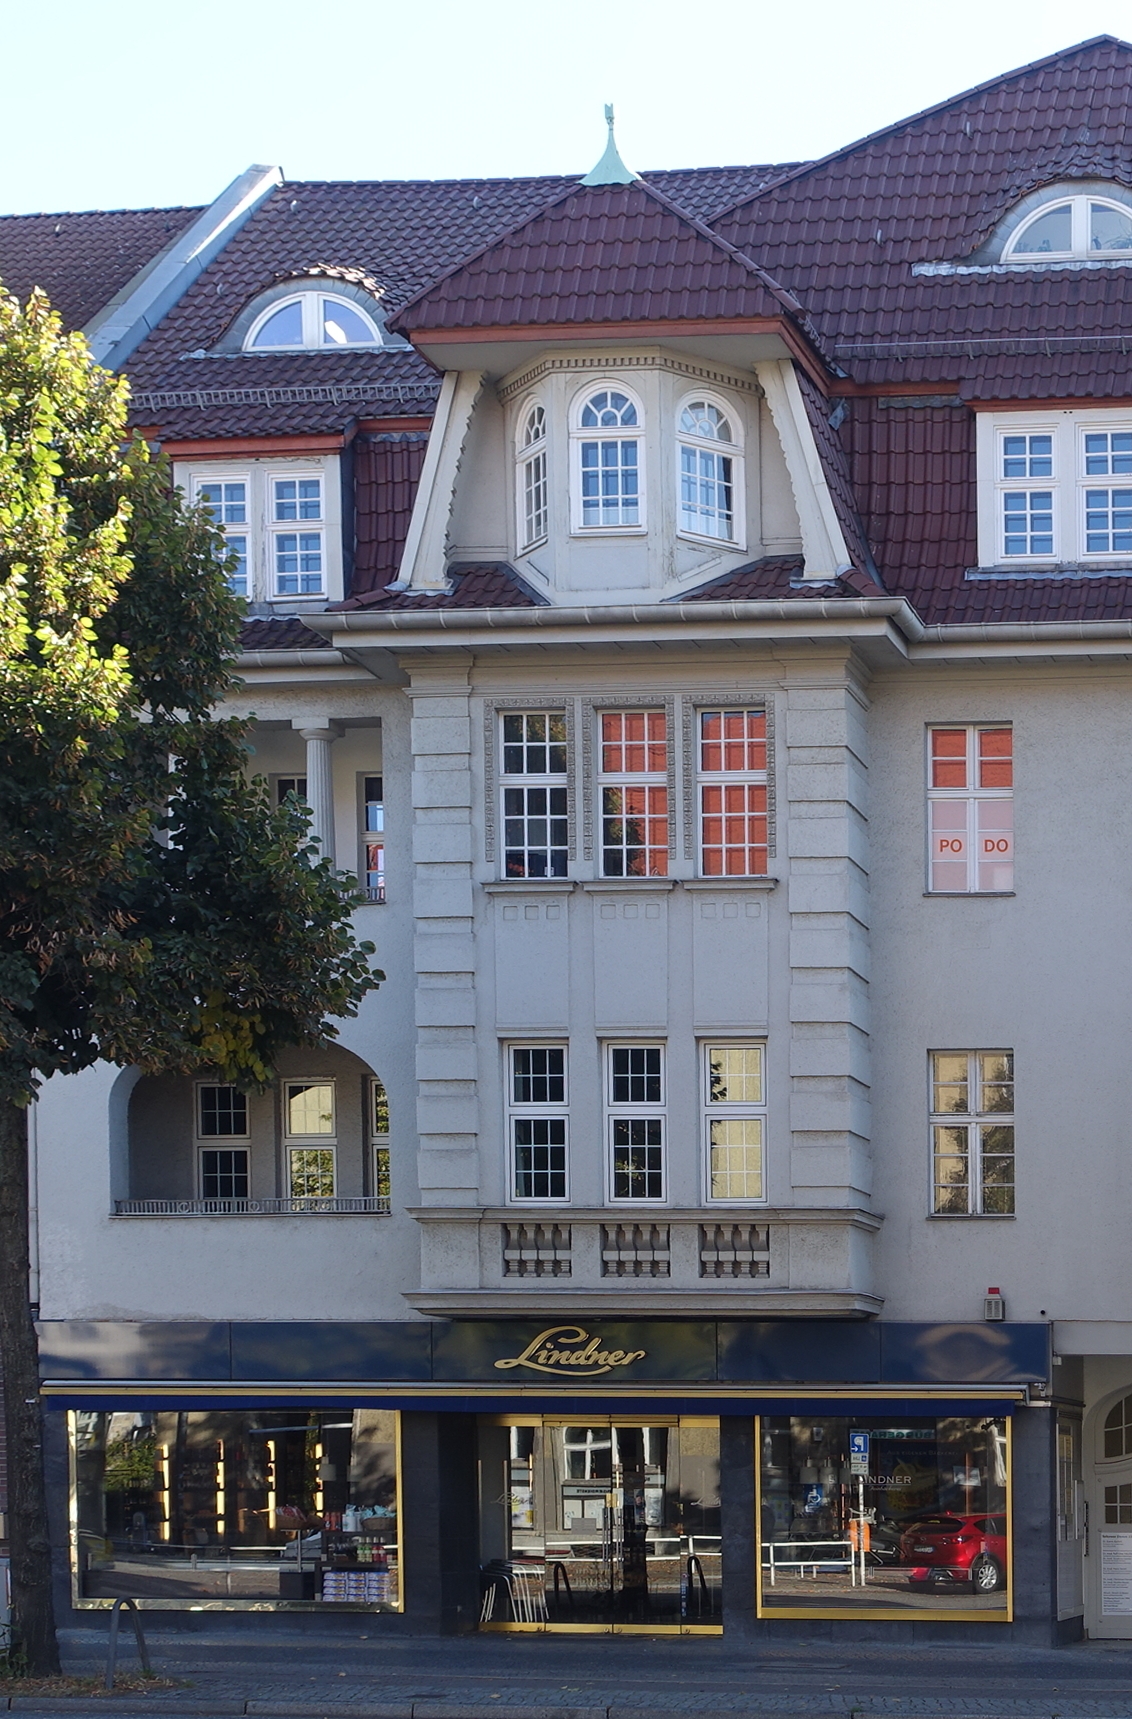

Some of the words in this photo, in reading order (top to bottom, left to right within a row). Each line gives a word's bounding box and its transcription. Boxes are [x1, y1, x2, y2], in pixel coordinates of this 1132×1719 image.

[938, 838, 963, 853] PO
[983, 838, 1009, 853] DO
[494, 1325, 647, 1377] Lindner
